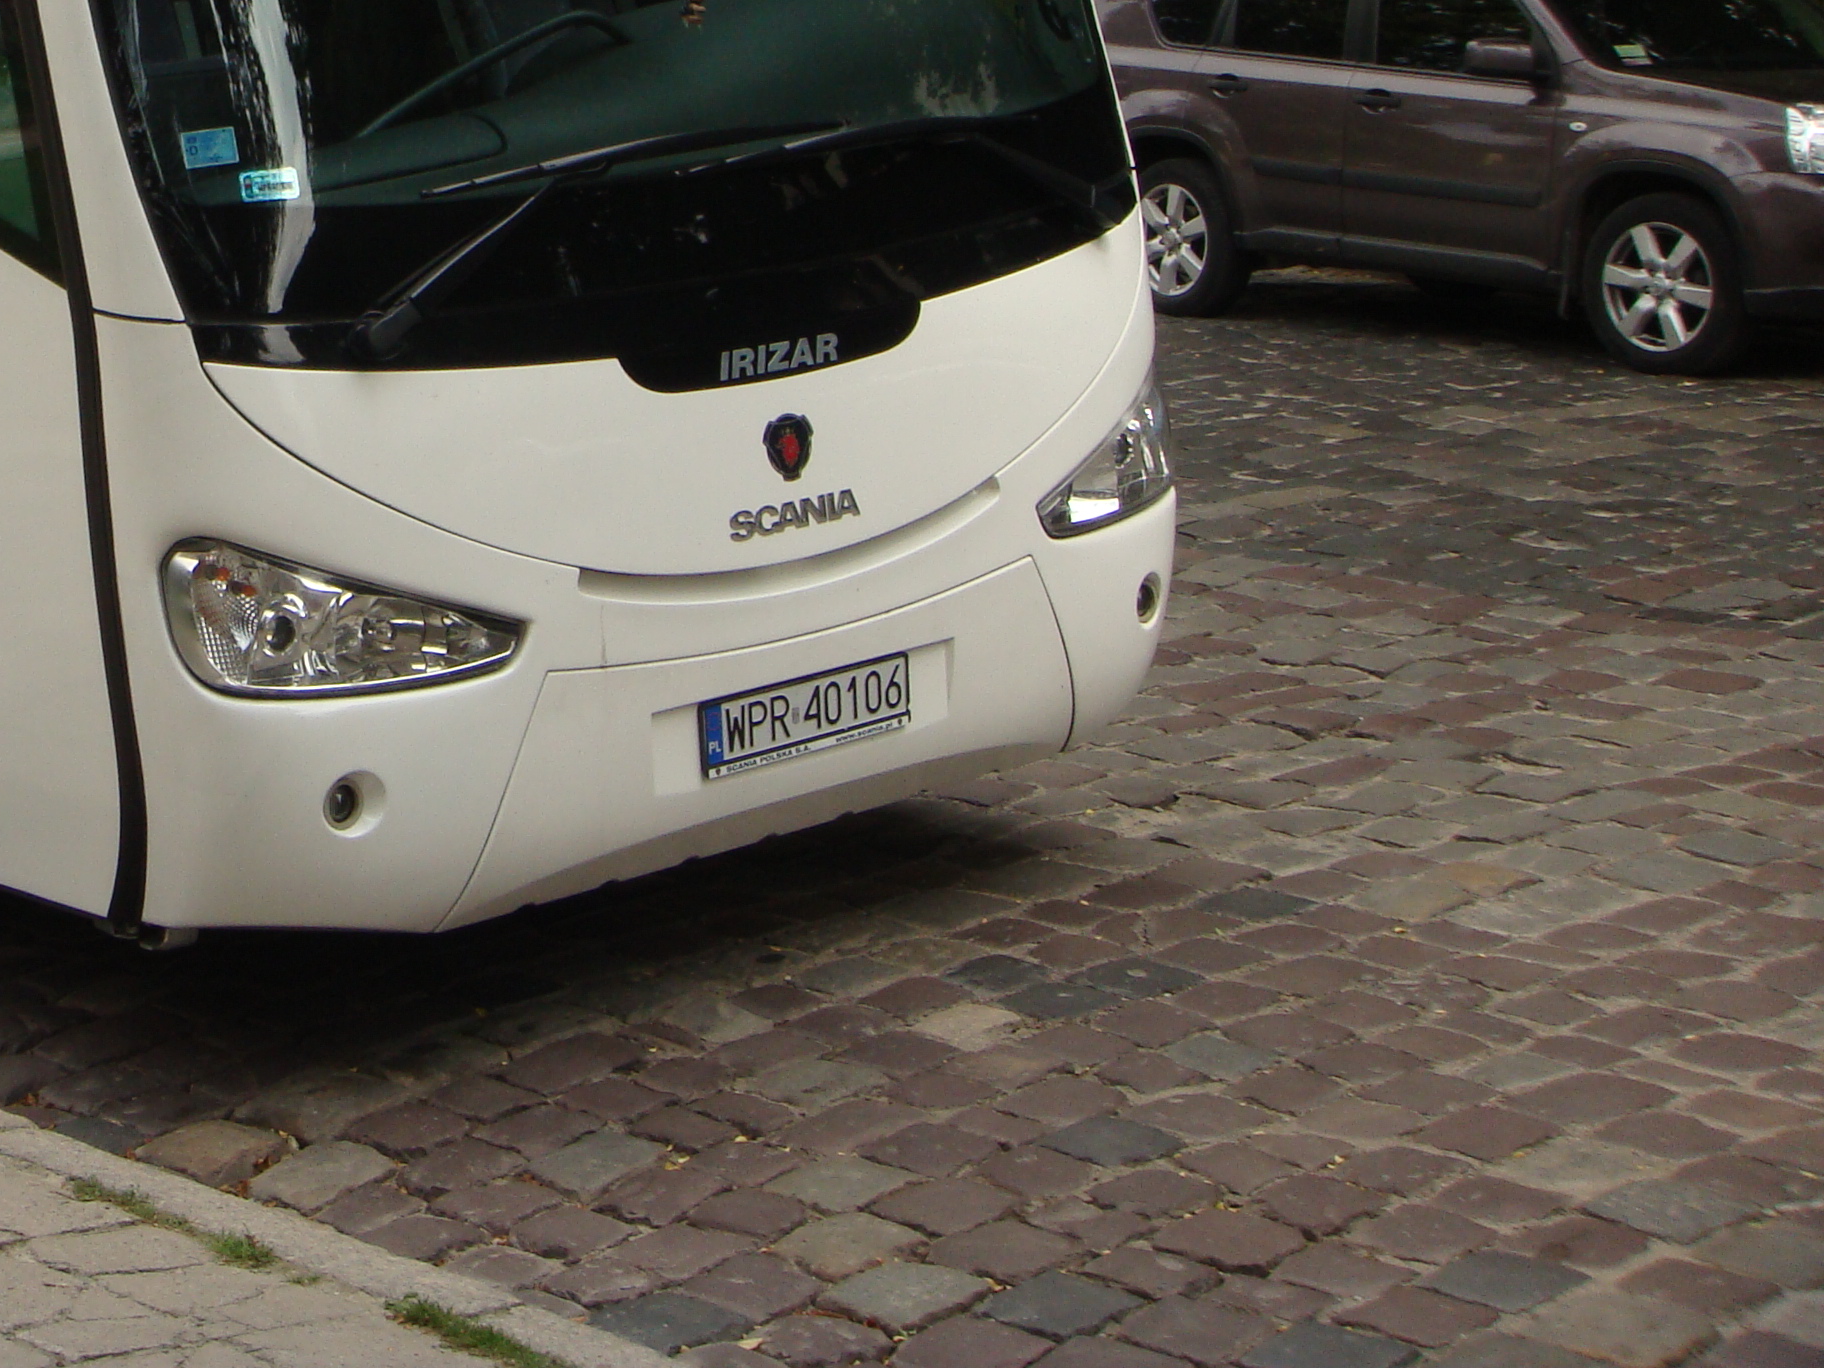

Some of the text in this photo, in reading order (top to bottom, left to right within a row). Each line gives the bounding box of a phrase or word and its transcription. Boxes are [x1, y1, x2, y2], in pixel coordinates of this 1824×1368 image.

[720, 333, 839, 381] IRIZAR
[729, 488, 861, 542] SCANIA
[708, 741, 722, 755] PL
[726, 759, 758, 773] SCANIA
[760, 749, 793, 764] POLSKA
